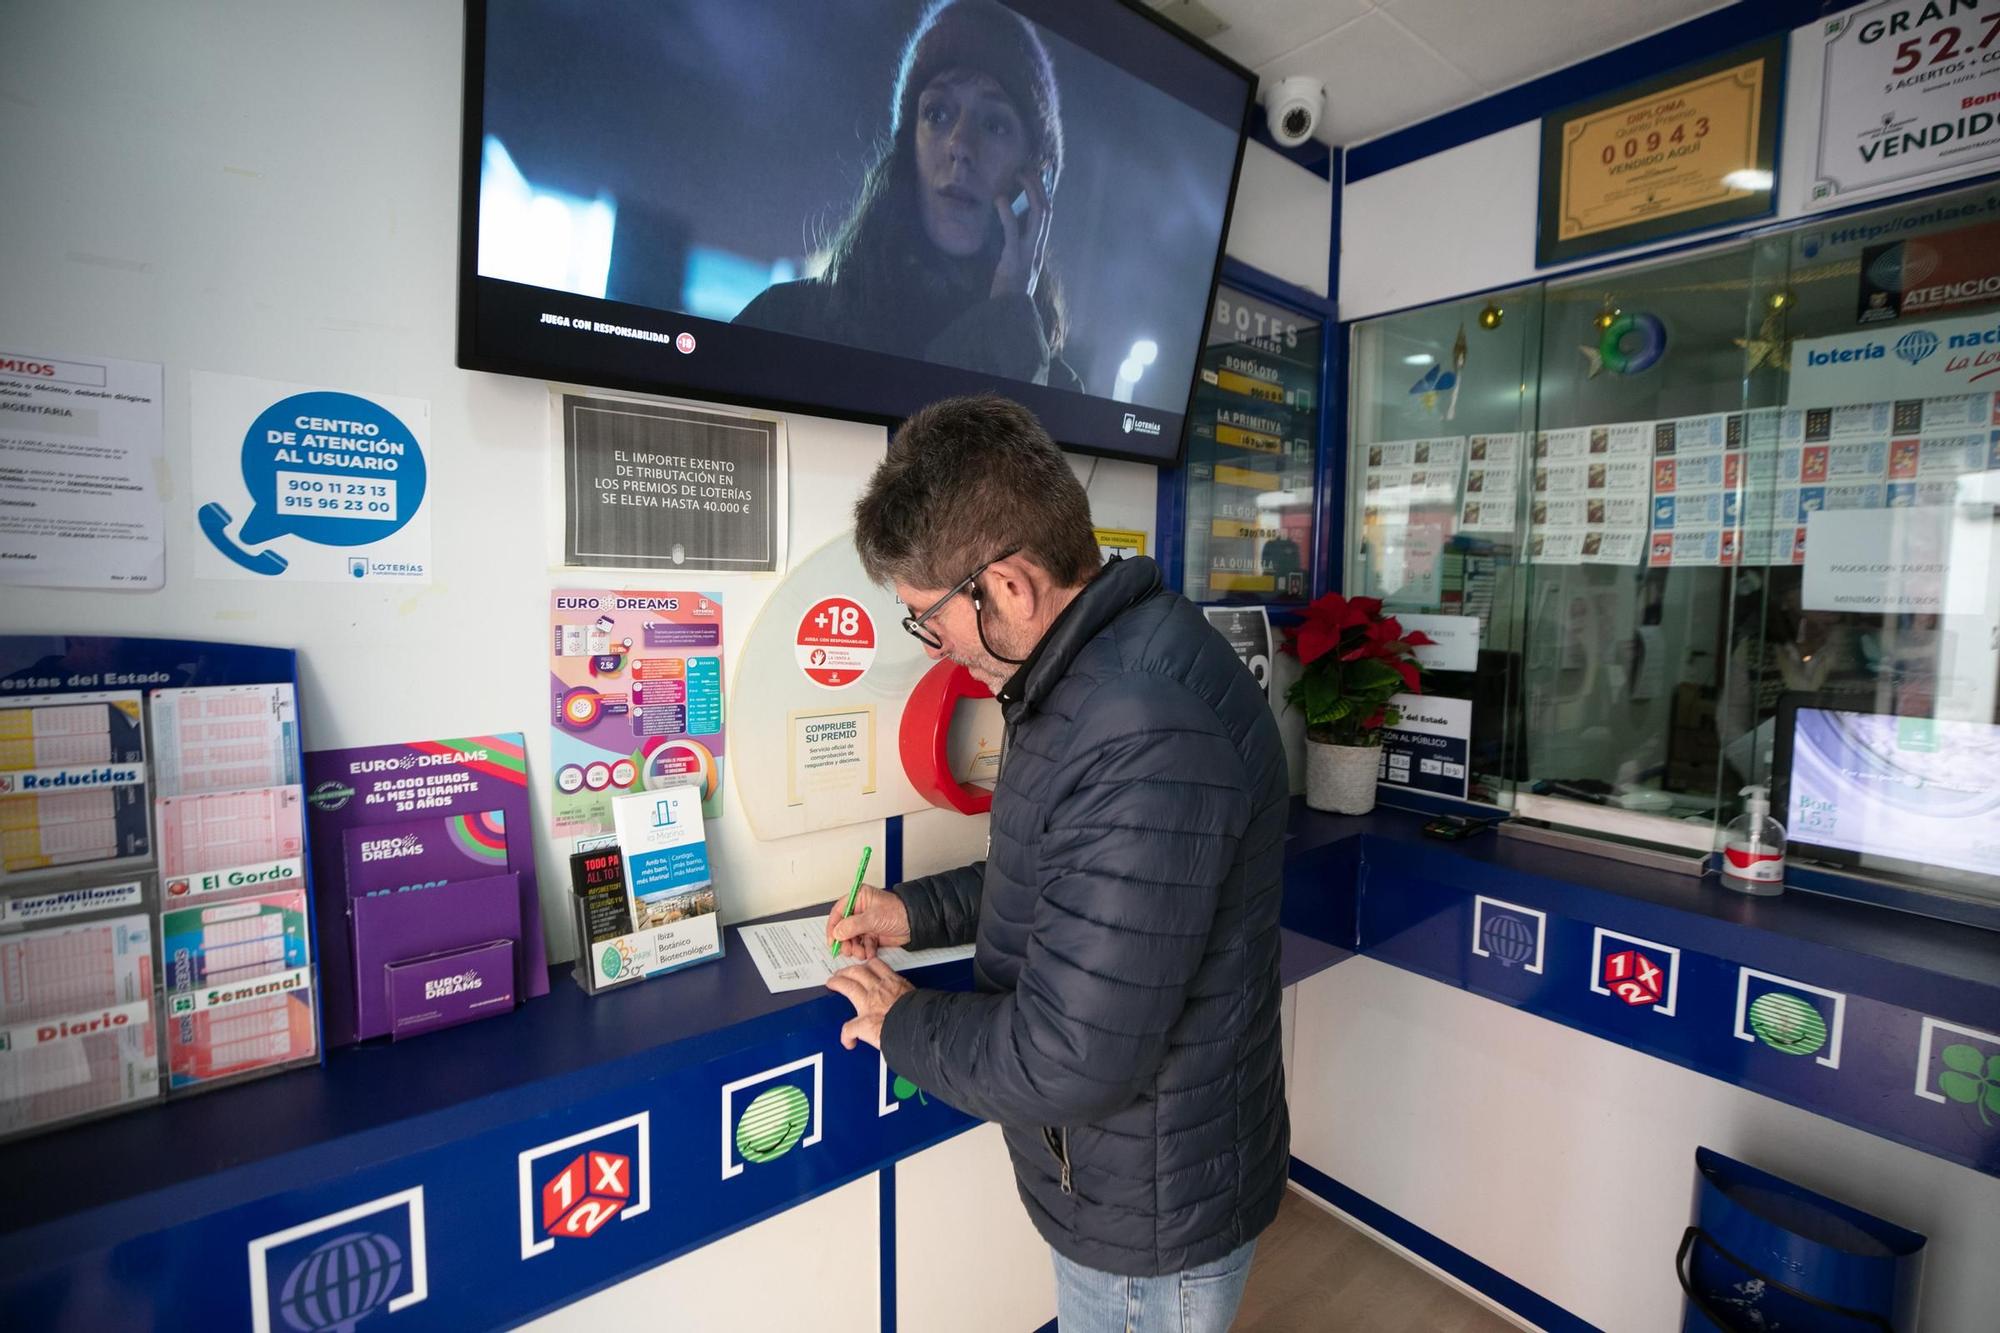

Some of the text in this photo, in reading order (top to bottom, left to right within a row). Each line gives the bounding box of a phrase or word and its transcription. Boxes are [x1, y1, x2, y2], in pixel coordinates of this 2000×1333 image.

[1859, 0, 1978, 44] GRAN
[1896, 60, 1966, 90] ACIERTOS
[1626, 99, 1685, 125] DIPLOMA
[1859, 112, 2000, 164] VENDID
[1609, 152, 1664, 176] VENDIDO
[540, 313, 570, 328] JUEGA
[572, 319, 591, 331] CON
[593, 322, 670, 344] RESPONSABILIDAD
[1216, 301, 1297, 348] BOTES
[1808, 342, 1886, 366] lotería
[1945, 356, 1970, 372] La
[1226, 355, 1278, 381] BONOLOTO
[295, 416, 379, 437] CENTRO
[1217, 408, 1281, 432] LA PRIMITIVA
[267, 430, 404, 456] DE ATENCIÓN
[274, 449, 399, 472] AL USUARIO
[614, 450, 735, 473] EL IMPORTE EXENTO
[616, 465, 733, 486] DE TRIBUTACIÓN EN
[288, 479, 387, 497] 900 11 23 13
[595, 478, 752, 501] LOS PREMIOS DE LOTERÍAS
[284, 496, 390, 513] 915 96 23 00
[602, 493, 750, 514] SE ELEVA HASTA 40.000 €
[372, 562, 424, 573] LOTERÍAS
[1213, 557, 1226, 568] LA
[557, 597, 678, 610] EURO DREAMS
[814, 606, 859, 636] +18
[68, 673, 98, 687] del
[103, 671, 171, 686] Estado
[805, 720, 856, 733] COMPRUEBE
[1406, 713, 1448, 725] del Estado
[805, 730, 857, 743] SU PREMIO
[1400, 734, 1447, 748] AL PÚBLICO
[350, 749, 488, 775] EURO DREAMS
[804, 760, 834, 769] resguardos
[810, 751, 847, 761] comprobación
[23, 768, 137, 790] Reducidas
[373, 772, 469, 792] 20.000 EUROS
[365, 781, 479, 805] AL MES DURANTE
[396, 793, 452, 813] 30 AÑOS
[361, 838, 424, 863] EURO DREAMS
[584, 857, 607, 871] TODO
[202, 866, 293, 891] El Gordo
[587, 871, 602, 884] ALL
[604, 868, 614, 880] TO
[12, 886, 136, 911] EuroMillones
[657, 931, 675, 941] Ibiza
[658, 938, 691, 952] Botánico
[660, 943, 713, 963] Biotecnológico
[1612, 955, 1658, 990] 1 X
[208, 974, 302, 1006] Semanal
[425, 973, 483, 1001] EURO DREAMS
[1617, 982, 1652, 1004] 2
[37, 1012, 129, 1043] Diario
[553, 1156, 624, 1210] 1 X
[566, 1202, 618, 1232] 2
